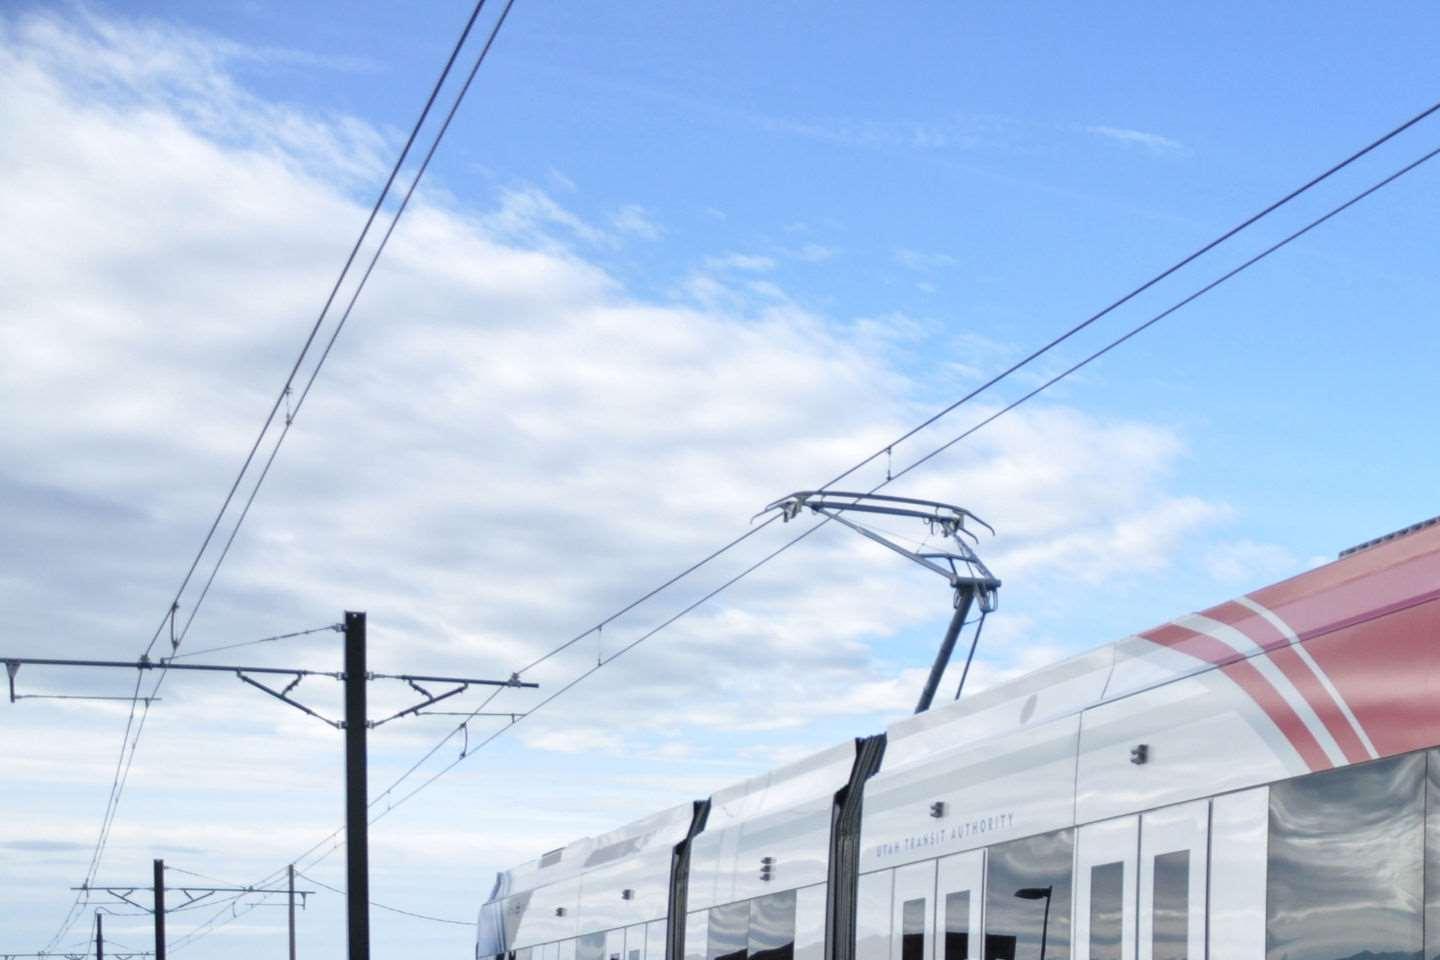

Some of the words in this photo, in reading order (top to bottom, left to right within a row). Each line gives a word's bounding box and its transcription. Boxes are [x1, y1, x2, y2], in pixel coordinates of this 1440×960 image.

[876, 842, 900, 857] UTAH
[905, 829, 945, 851] TRANSIT
[951, 812, 1014, 840] AUTHORITY
